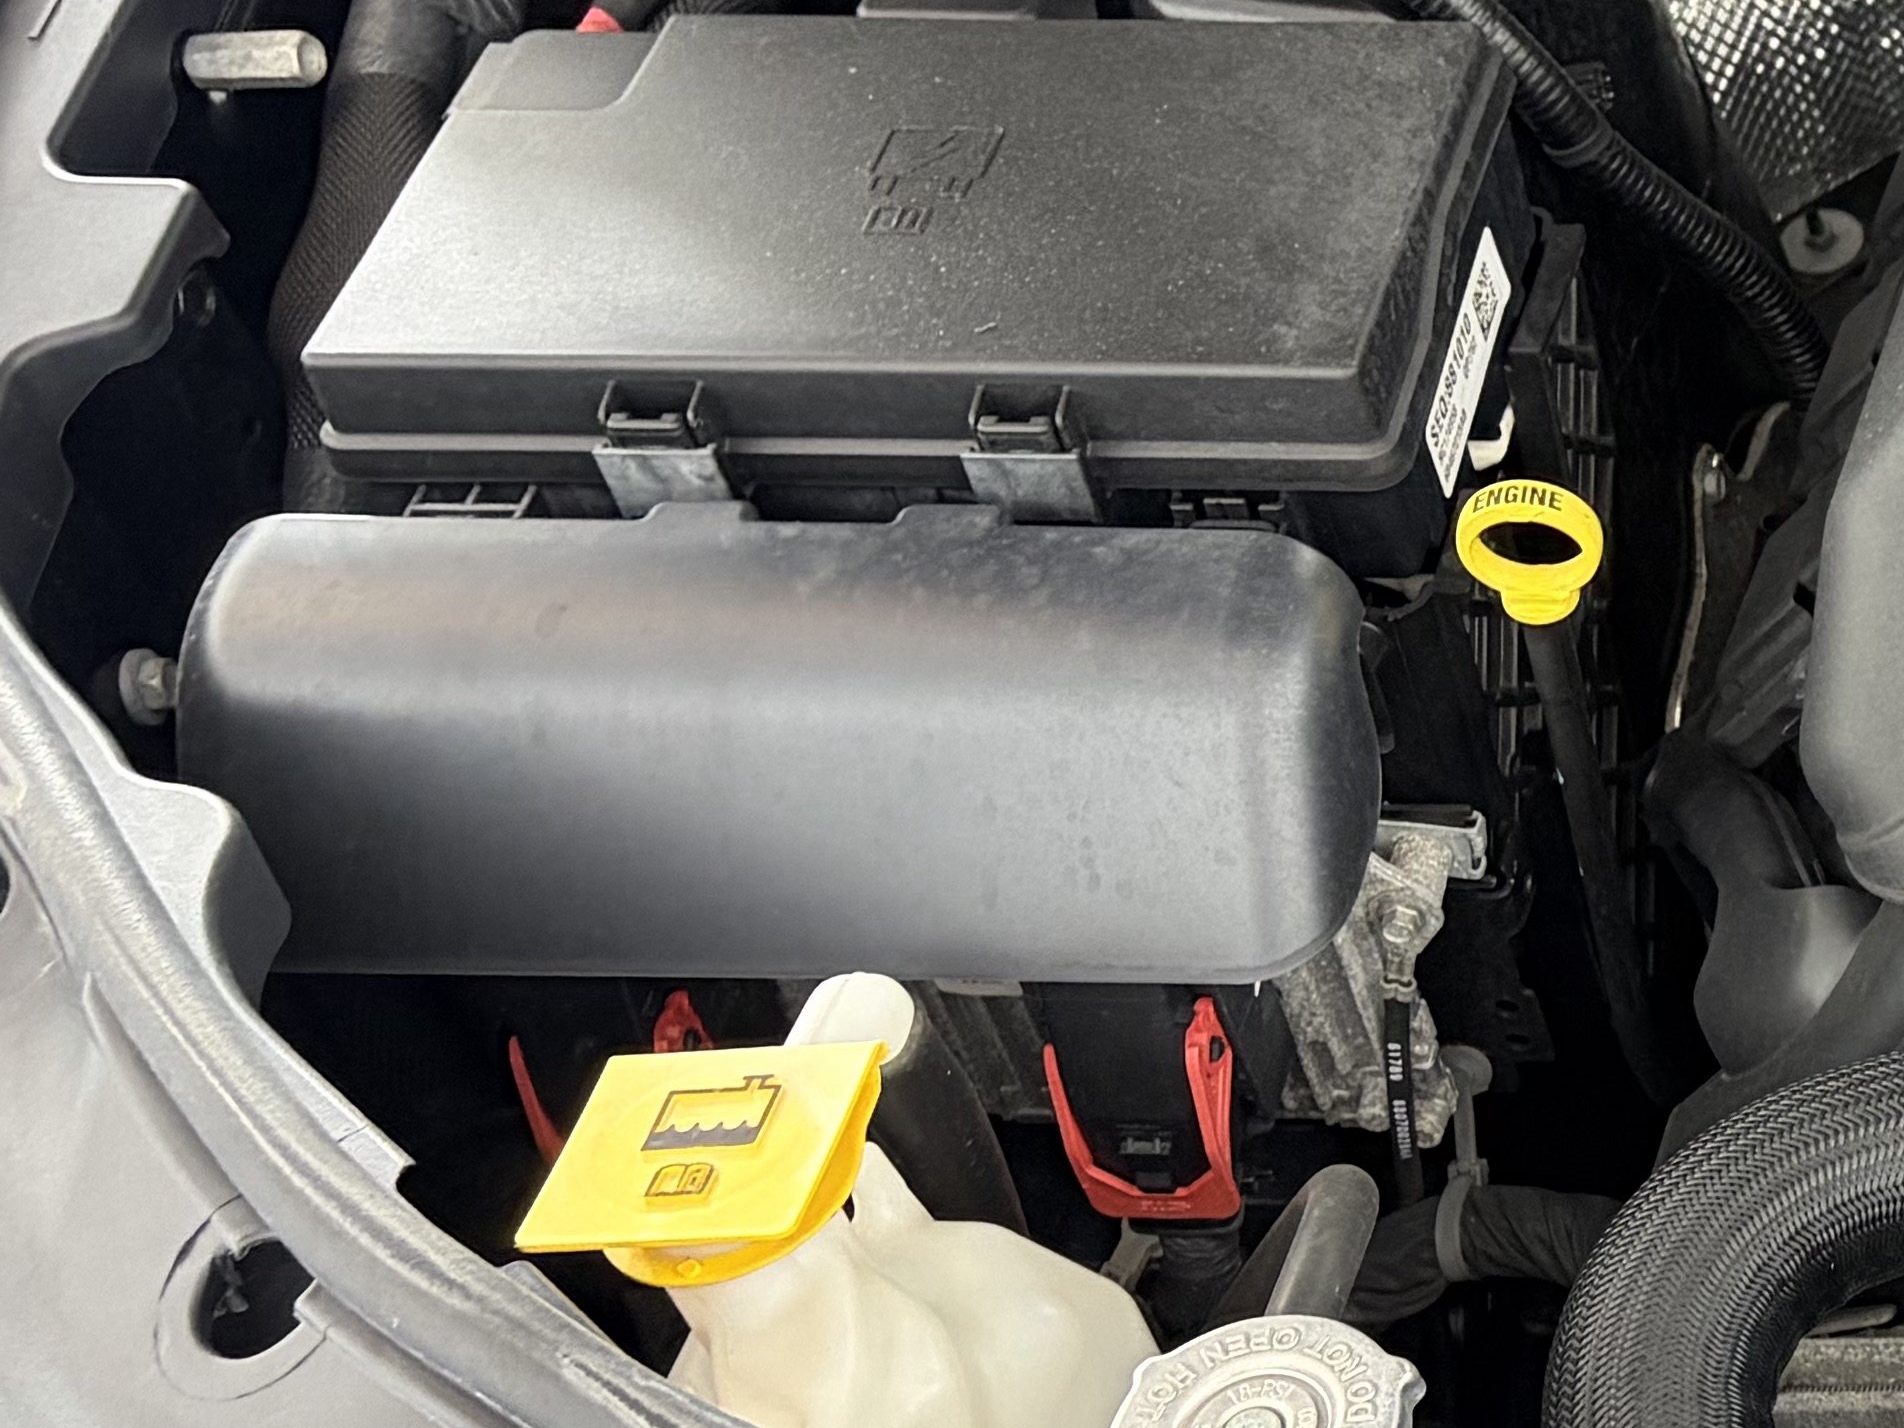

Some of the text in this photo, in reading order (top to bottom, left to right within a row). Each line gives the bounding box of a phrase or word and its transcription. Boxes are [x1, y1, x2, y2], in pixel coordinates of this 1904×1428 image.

[1471, 488, 1564, 513] ENGINE
[1201, 1326, 1302, 1368] OPEN
[1135, 1365, 1198, 1422] HOT
